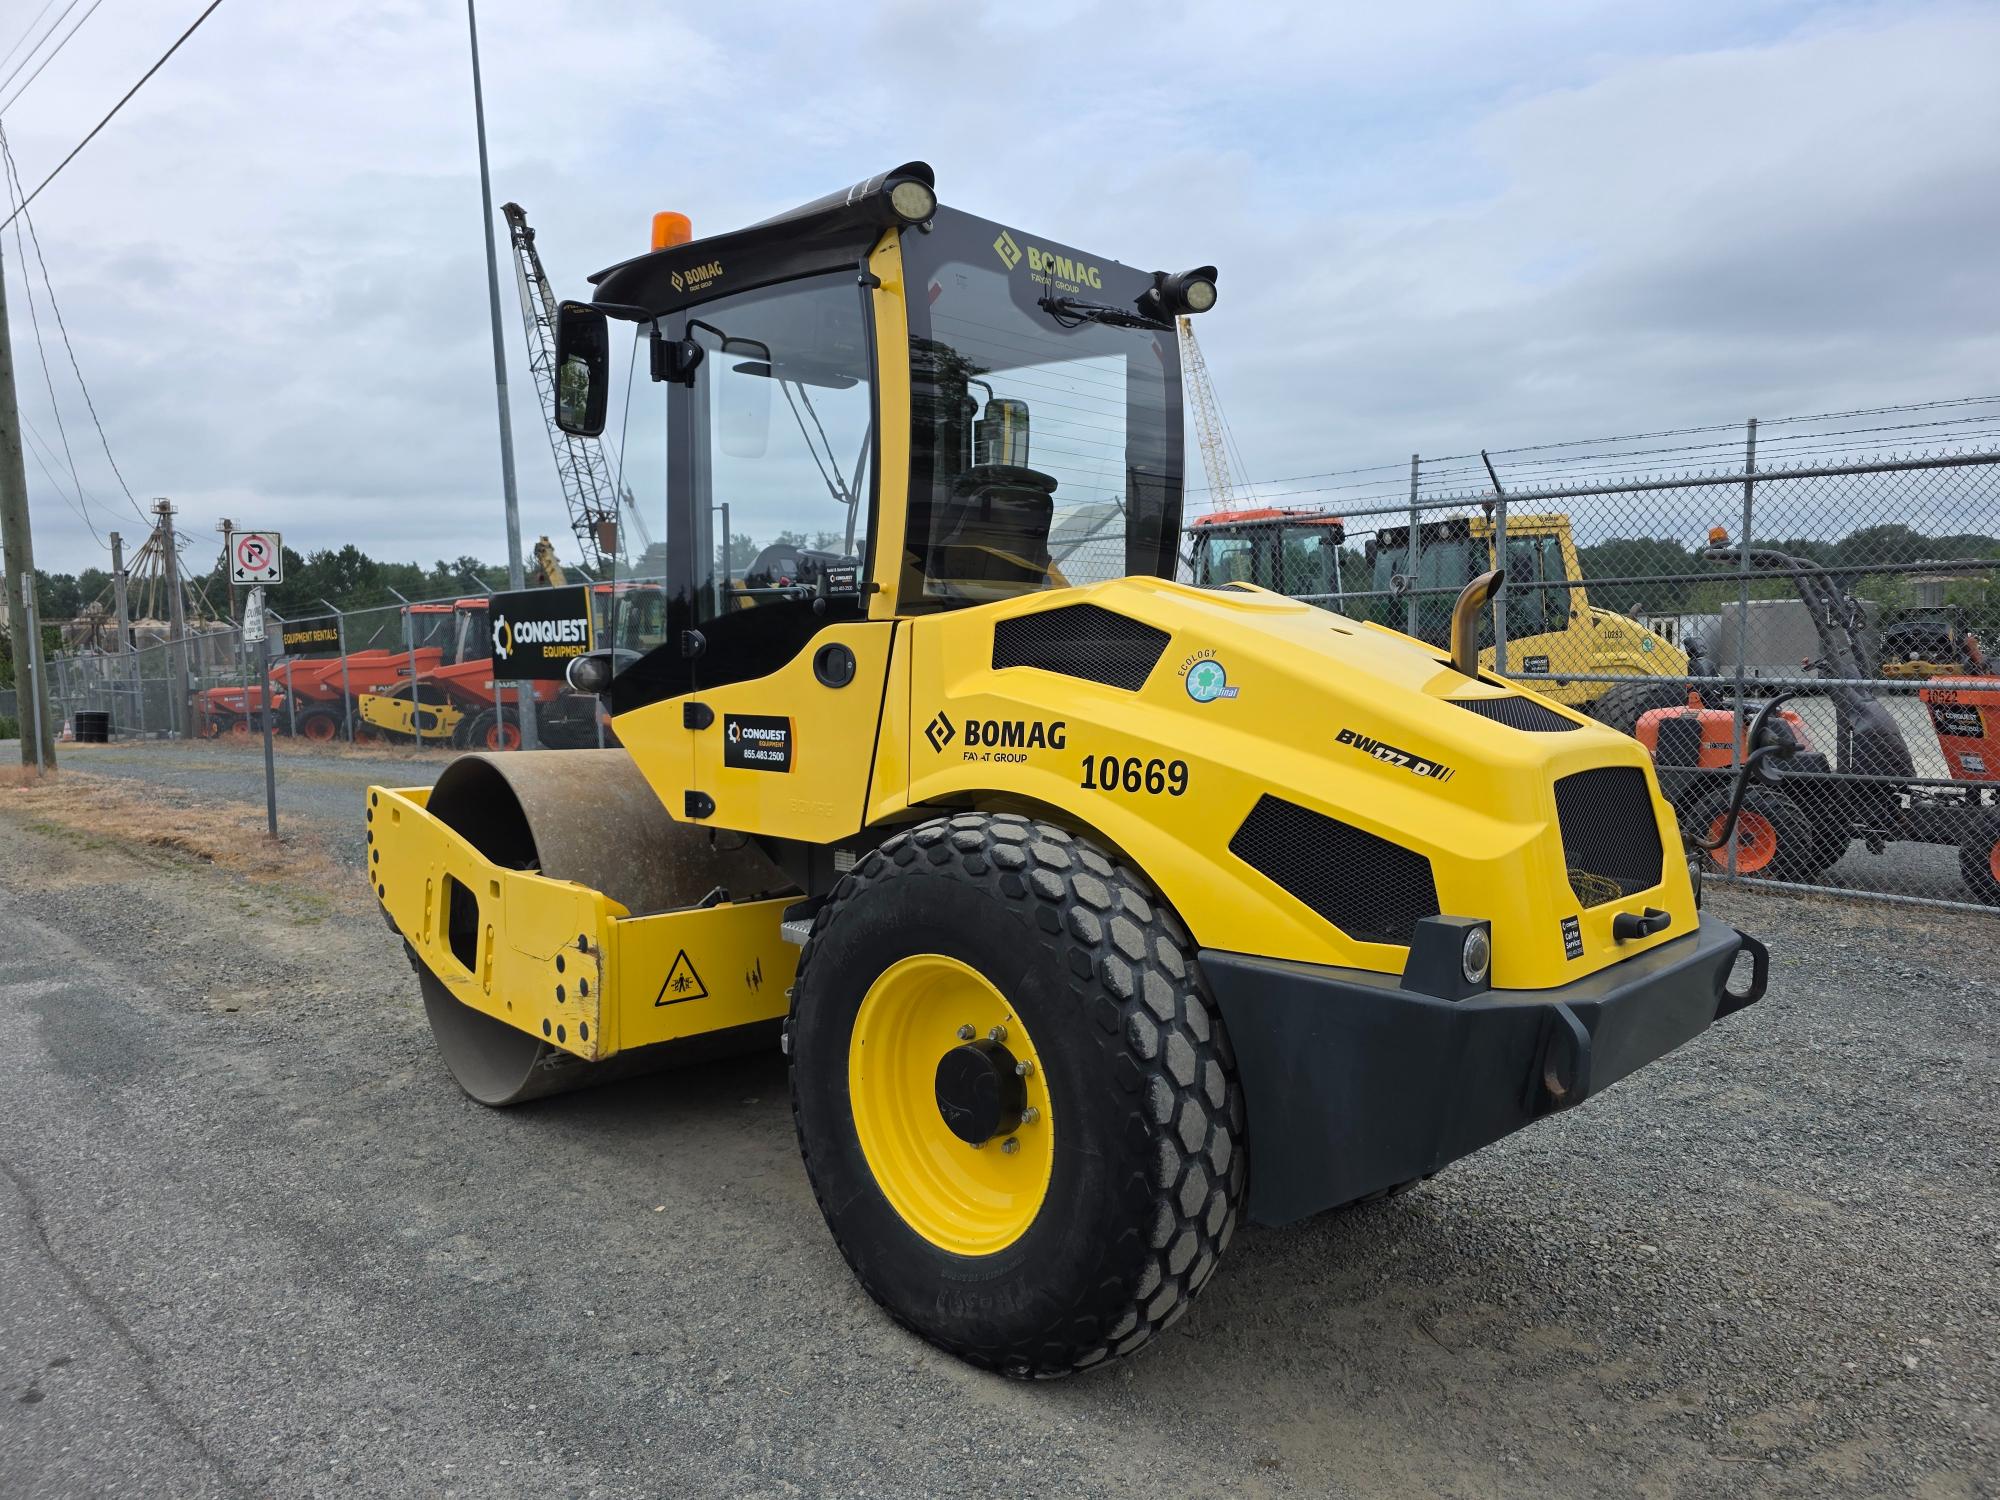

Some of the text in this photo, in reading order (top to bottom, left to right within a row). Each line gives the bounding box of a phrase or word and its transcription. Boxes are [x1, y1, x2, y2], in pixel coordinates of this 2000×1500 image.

[684, 260, 723, 285] BOMAG
[1027, 246, 1102, 289] BOMAG
[1055, 280, 1080, 293] GROUP
[283, 629, 338, 645] EQUIPMENT RENTALS
[514, 619, 588, 643] CONQUEST
[543, 645, 587, 658] EQUIPMENT
[1178, 650, 1217, 677] ECOLOGY
[742, 728, 786, 741] CONQUEST
[964, 720, 1066, 749] BOMAG
[743, 749, 785, 761] 855.483.2500
[993, 752, 1028, 763] GROUP
[1080, 754, 1189, 797] 10669
